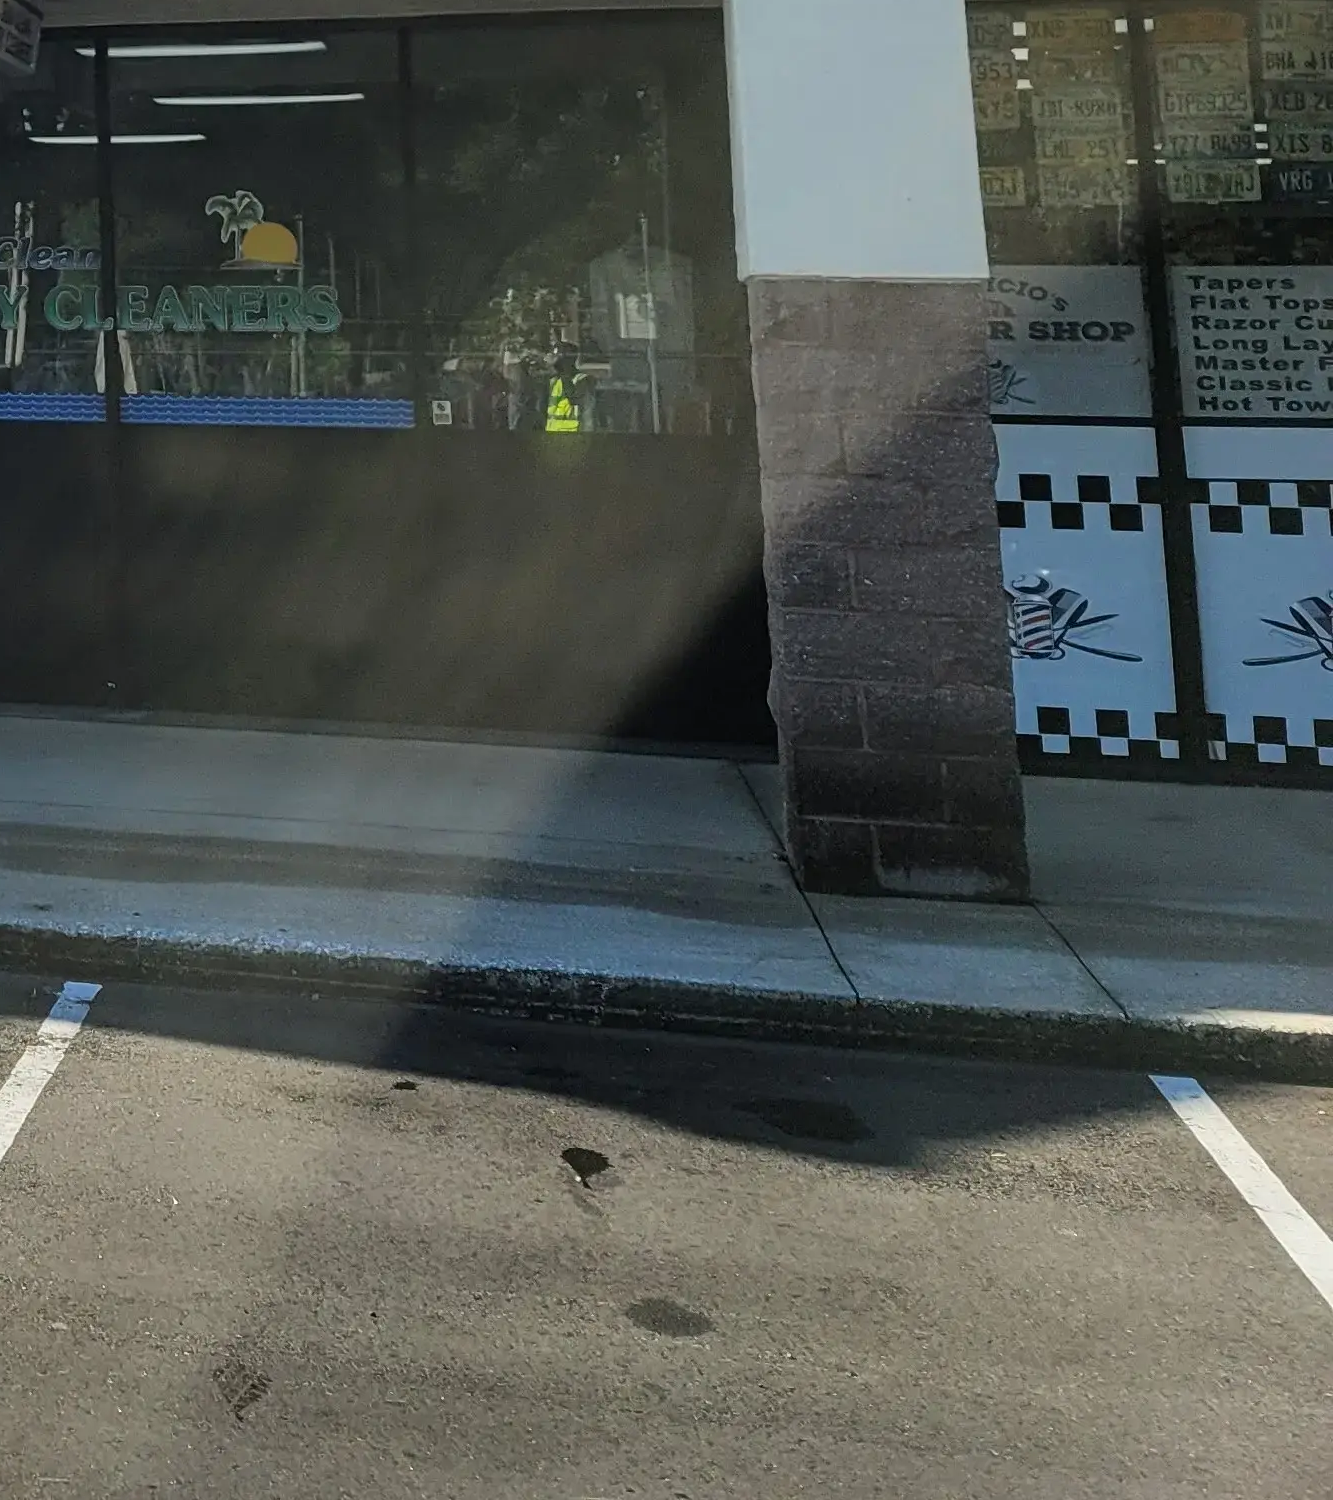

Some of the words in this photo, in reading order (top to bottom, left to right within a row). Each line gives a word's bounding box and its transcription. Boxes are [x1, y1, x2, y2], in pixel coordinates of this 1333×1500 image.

[1187, 274, 1296, 293] Tapers
[43, 284, 343, 333] CLEANERS
[1190, 295, 1251, 310] Flat
[1191, 315, 1281, 330] Razor
[1028, 320, 1135, 342] SHOP
[1193, 336, 1268, 354] Long
[1194, 355, 1305, 371] Master
[1196, 375, 1313, 391] Classic
[1198, 396, 1253, 411] Hot
[1265, 396, 1333, 412] Tow
